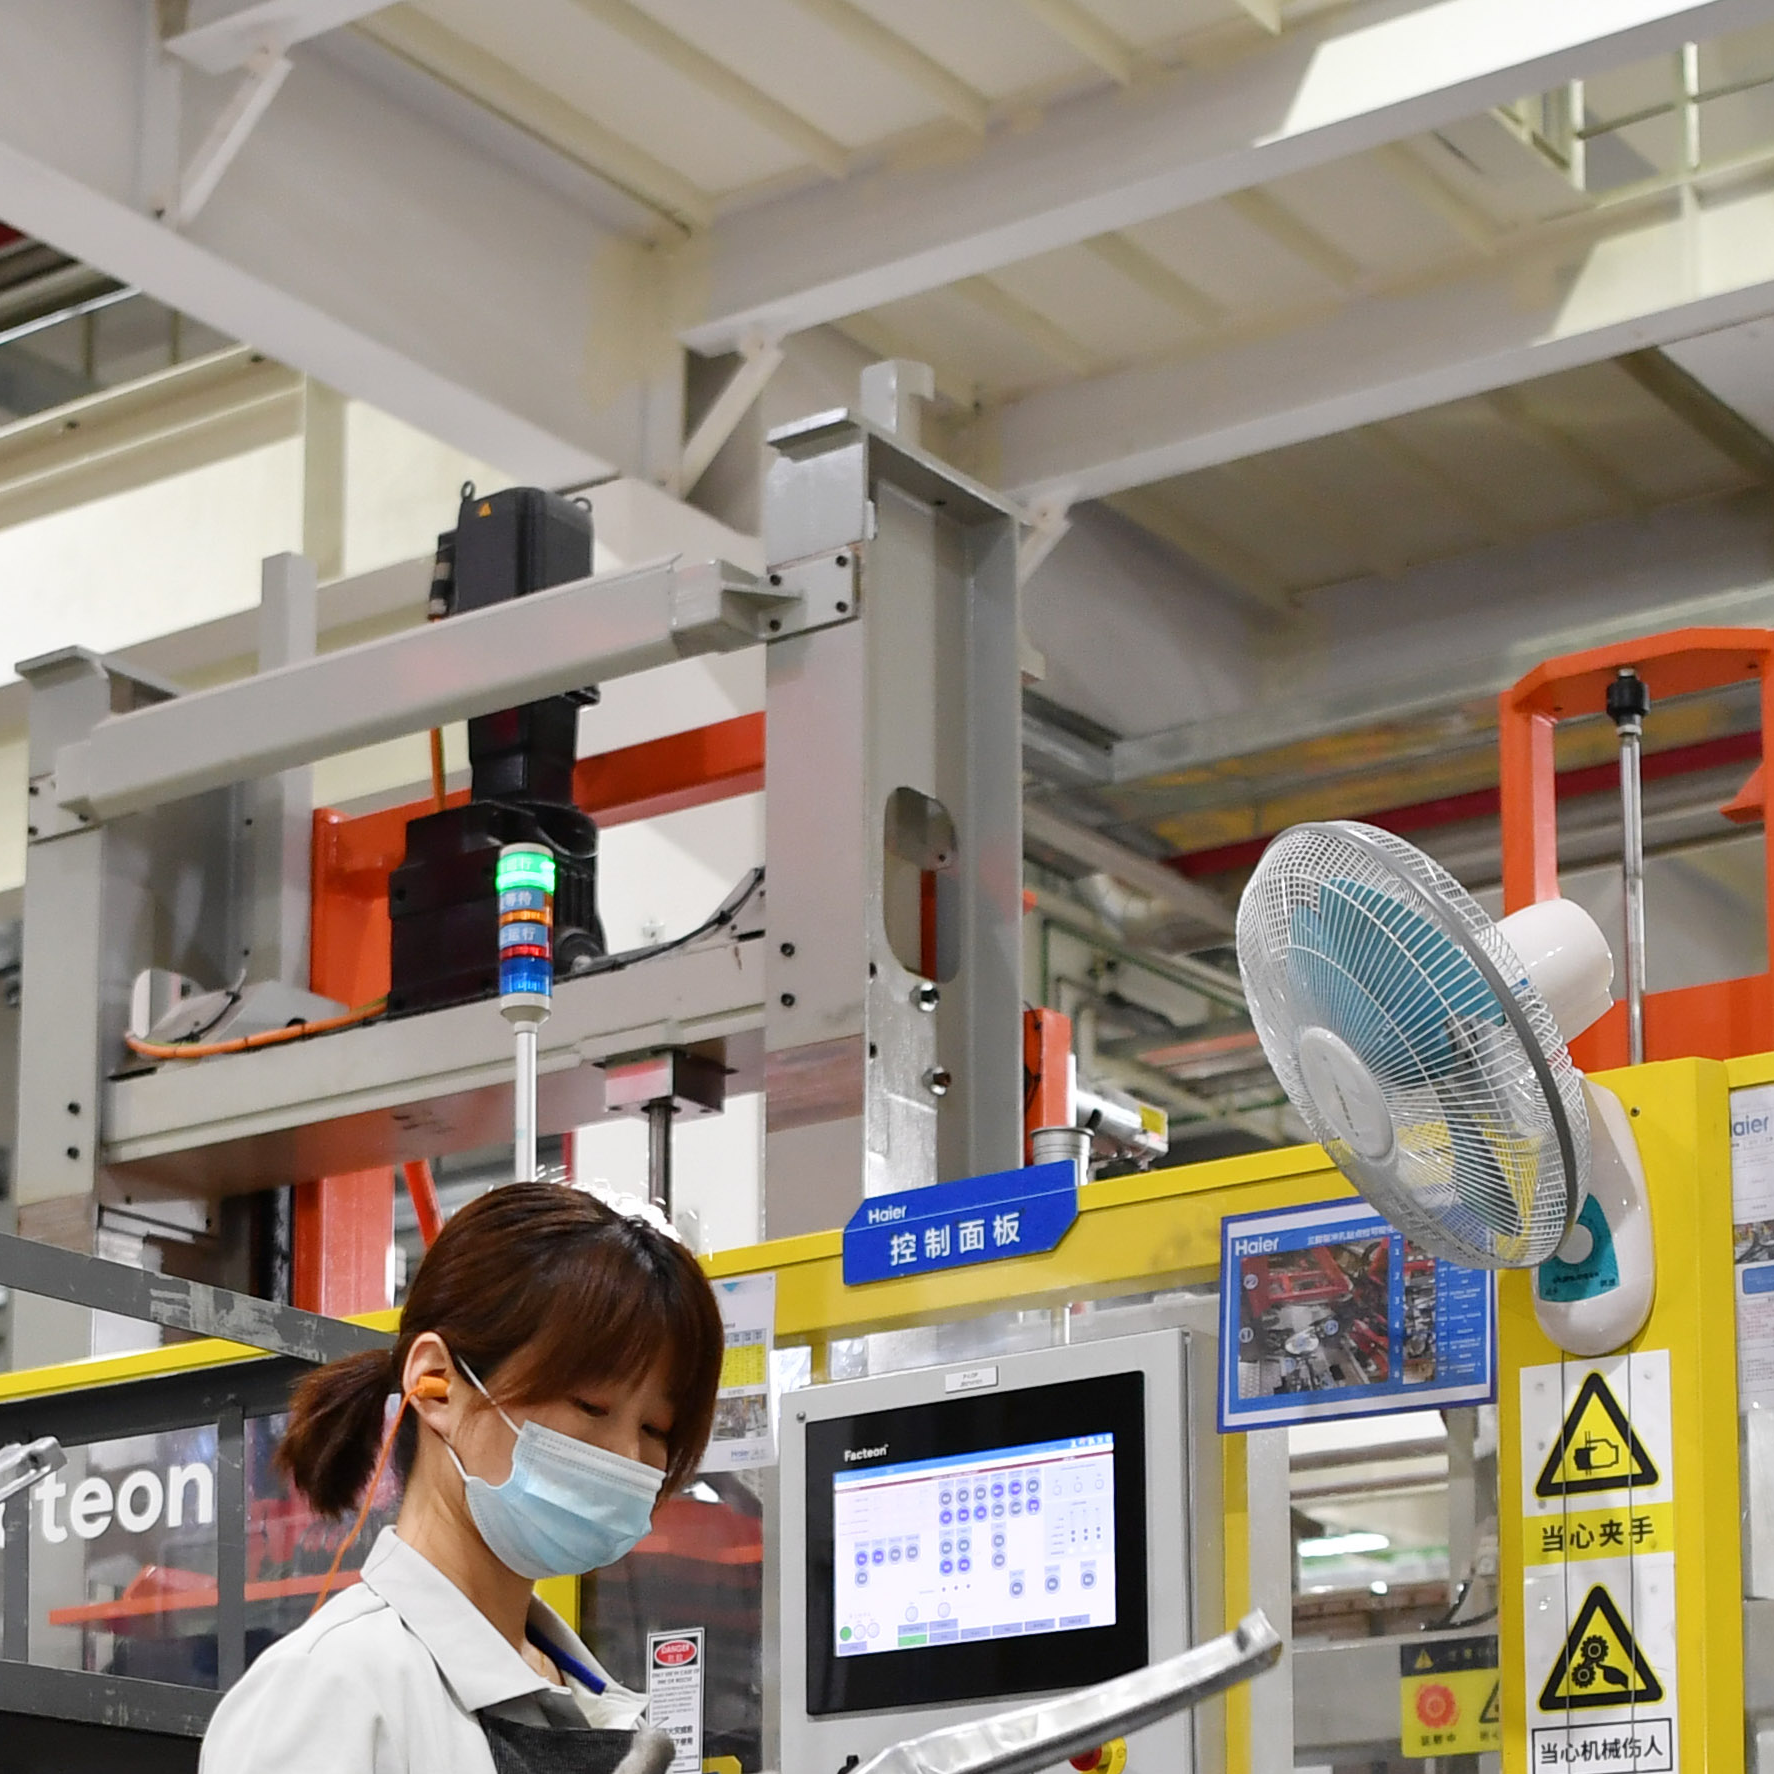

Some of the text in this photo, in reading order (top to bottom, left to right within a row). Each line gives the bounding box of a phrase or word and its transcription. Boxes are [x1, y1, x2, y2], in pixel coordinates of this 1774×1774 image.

[1731, 1114, 1770, 1138] aier
[868, 1205, 907, 1225] Haier
[890, 1212, 1021, 1267] 控制面板
[1234, 1235, 1279, 1257] Haier
[844, 1445, 888, 1462] Facteon
[1541, 1515, 1655, 1553] 当心夹手
[1539, 1734, 1664, 1765] 当心机械伤人
